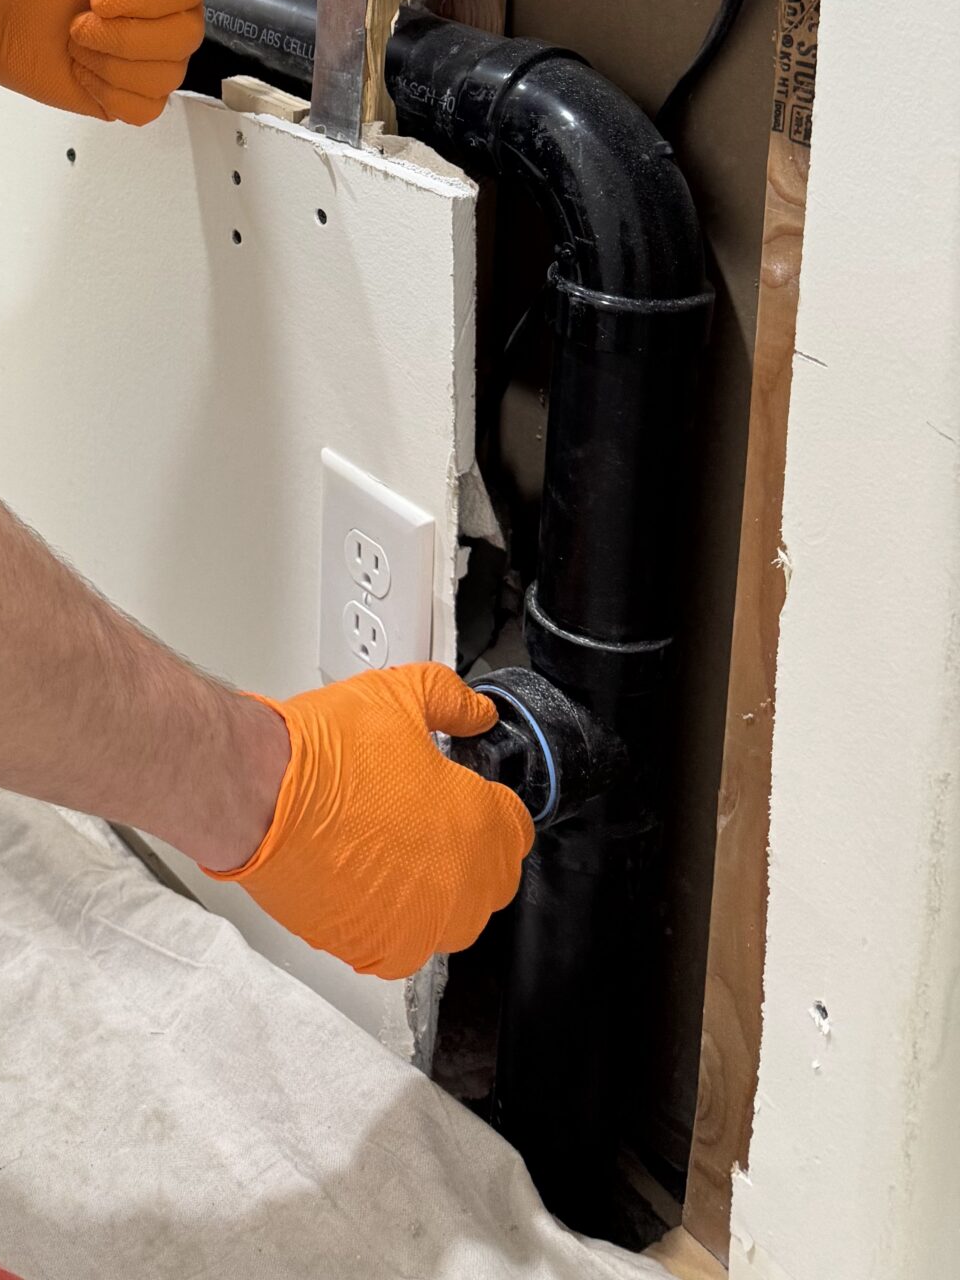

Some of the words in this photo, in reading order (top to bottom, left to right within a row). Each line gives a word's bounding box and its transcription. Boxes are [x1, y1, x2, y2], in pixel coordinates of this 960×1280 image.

[203, 7, 259, 39] EXTRUDED
[259, 28, 282, 48] ABS
[437, 85, 456, 113] 40
[776, 76, 789, 99] HT
